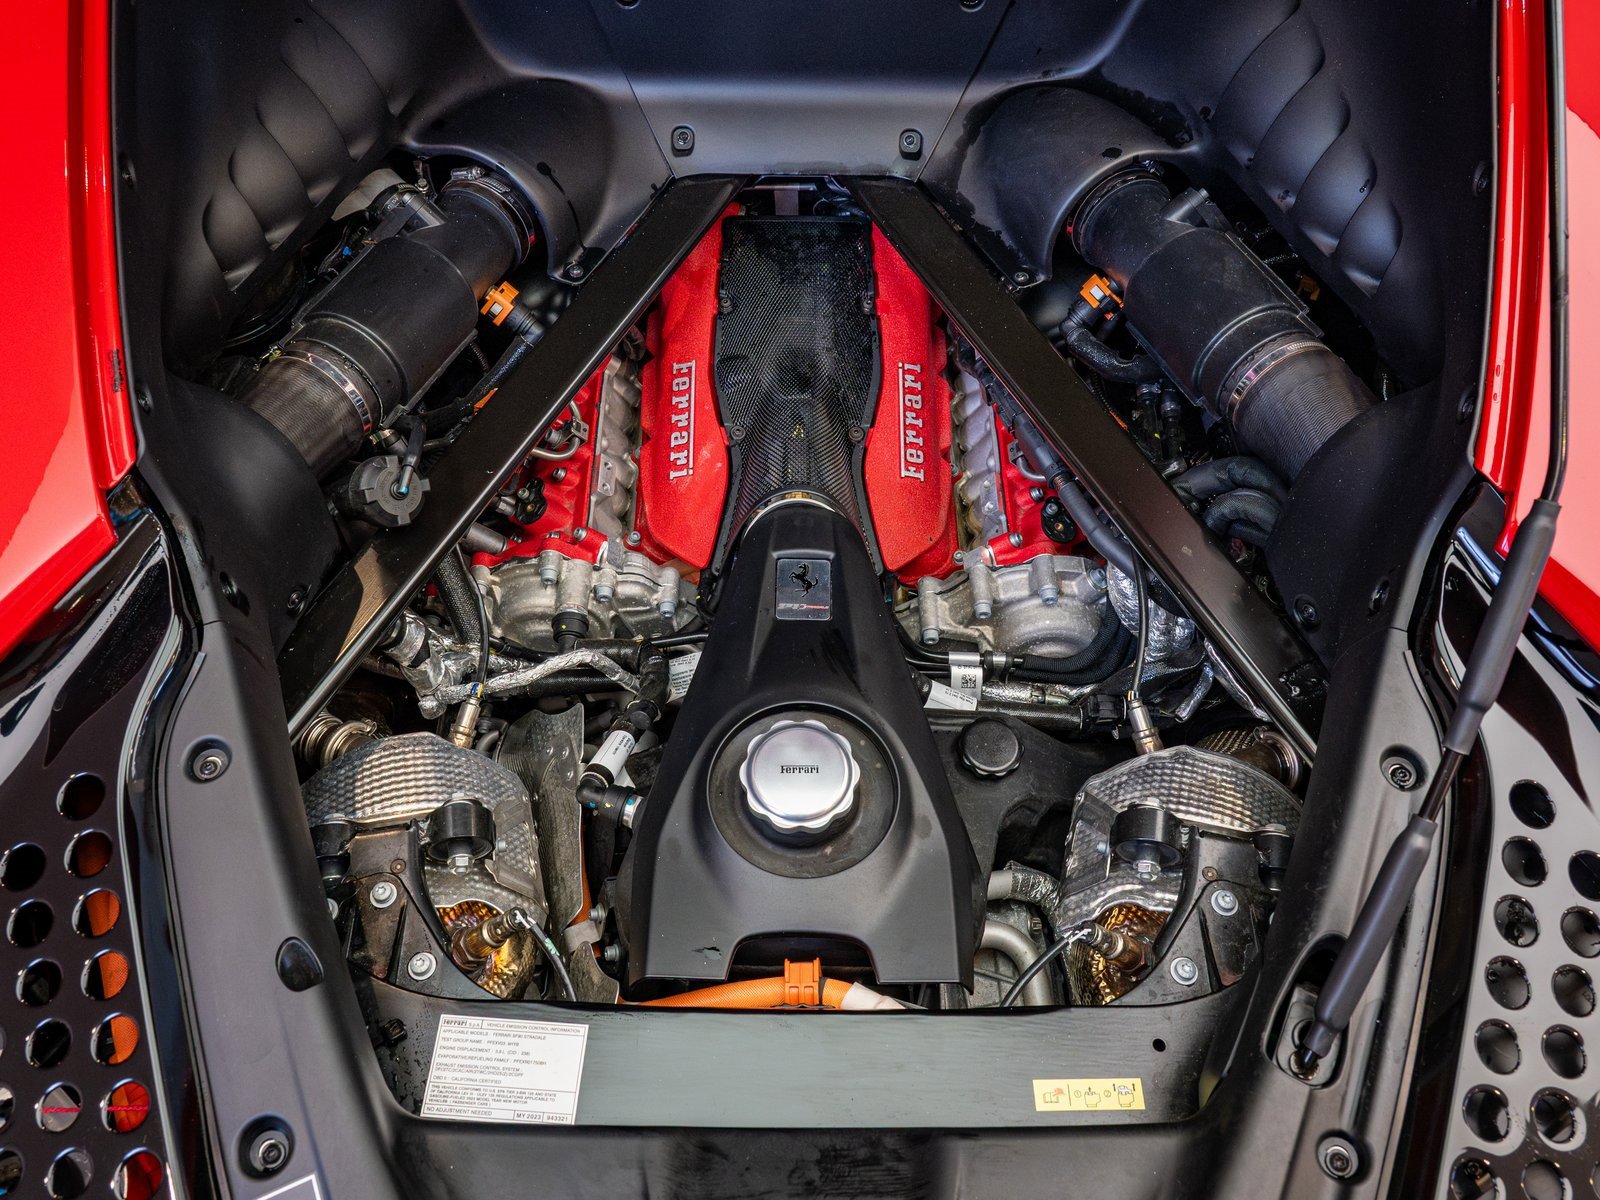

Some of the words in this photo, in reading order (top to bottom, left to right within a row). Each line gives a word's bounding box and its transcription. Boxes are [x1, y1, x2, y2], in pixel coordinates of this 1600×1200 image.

[670, 360, 696, 480] Ferrari
[898, 362, 924, 482] Ferrari
[780, 765, 819, 773] Ferrari
